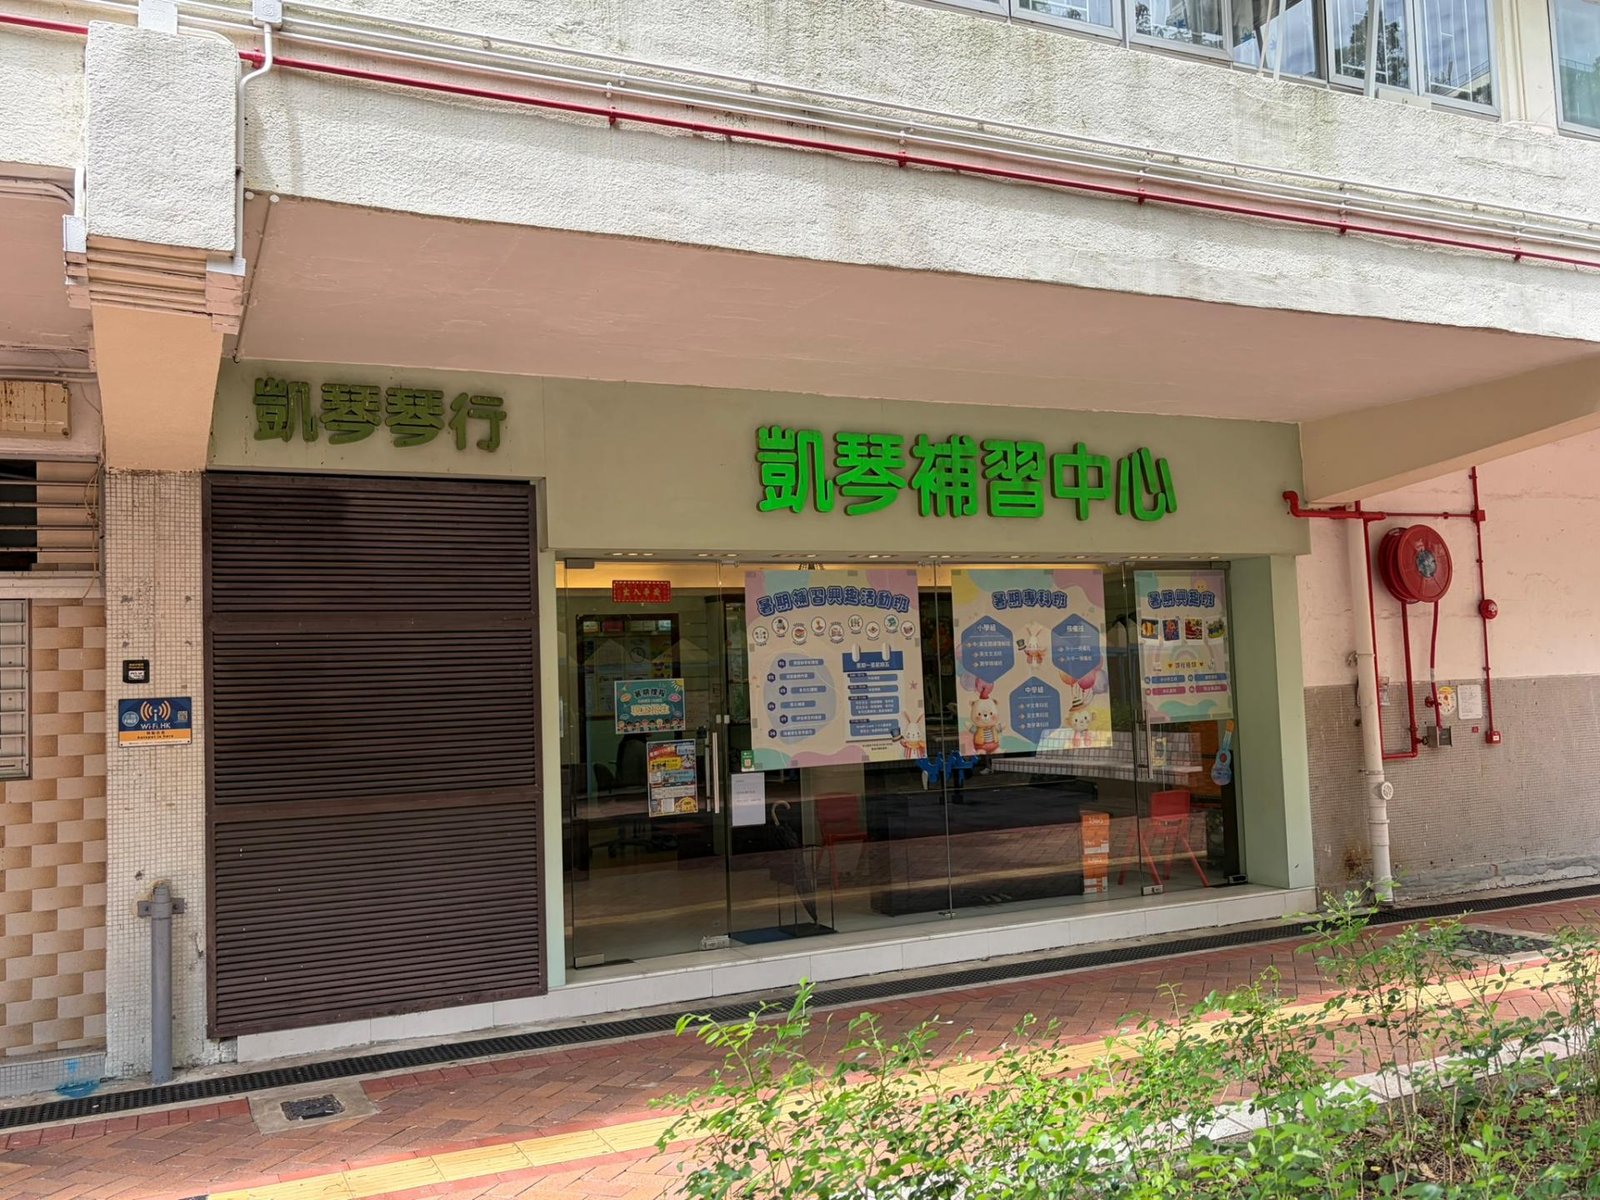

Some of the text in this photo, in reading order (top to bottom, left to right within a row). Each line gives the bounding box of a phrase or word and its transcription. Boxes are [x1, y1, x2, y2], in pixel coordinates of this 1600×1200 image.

[253, 377, 508, 452] 凱琴琴行
[755, 424, 1178, 522] 凱琴補習中心
[756, 586, 910, 617] 暑期補習興趣活動班
[992, 589, 1068, 609] 暑期專科班
[1148, 589, 1215, 609] 暑期興趣班
